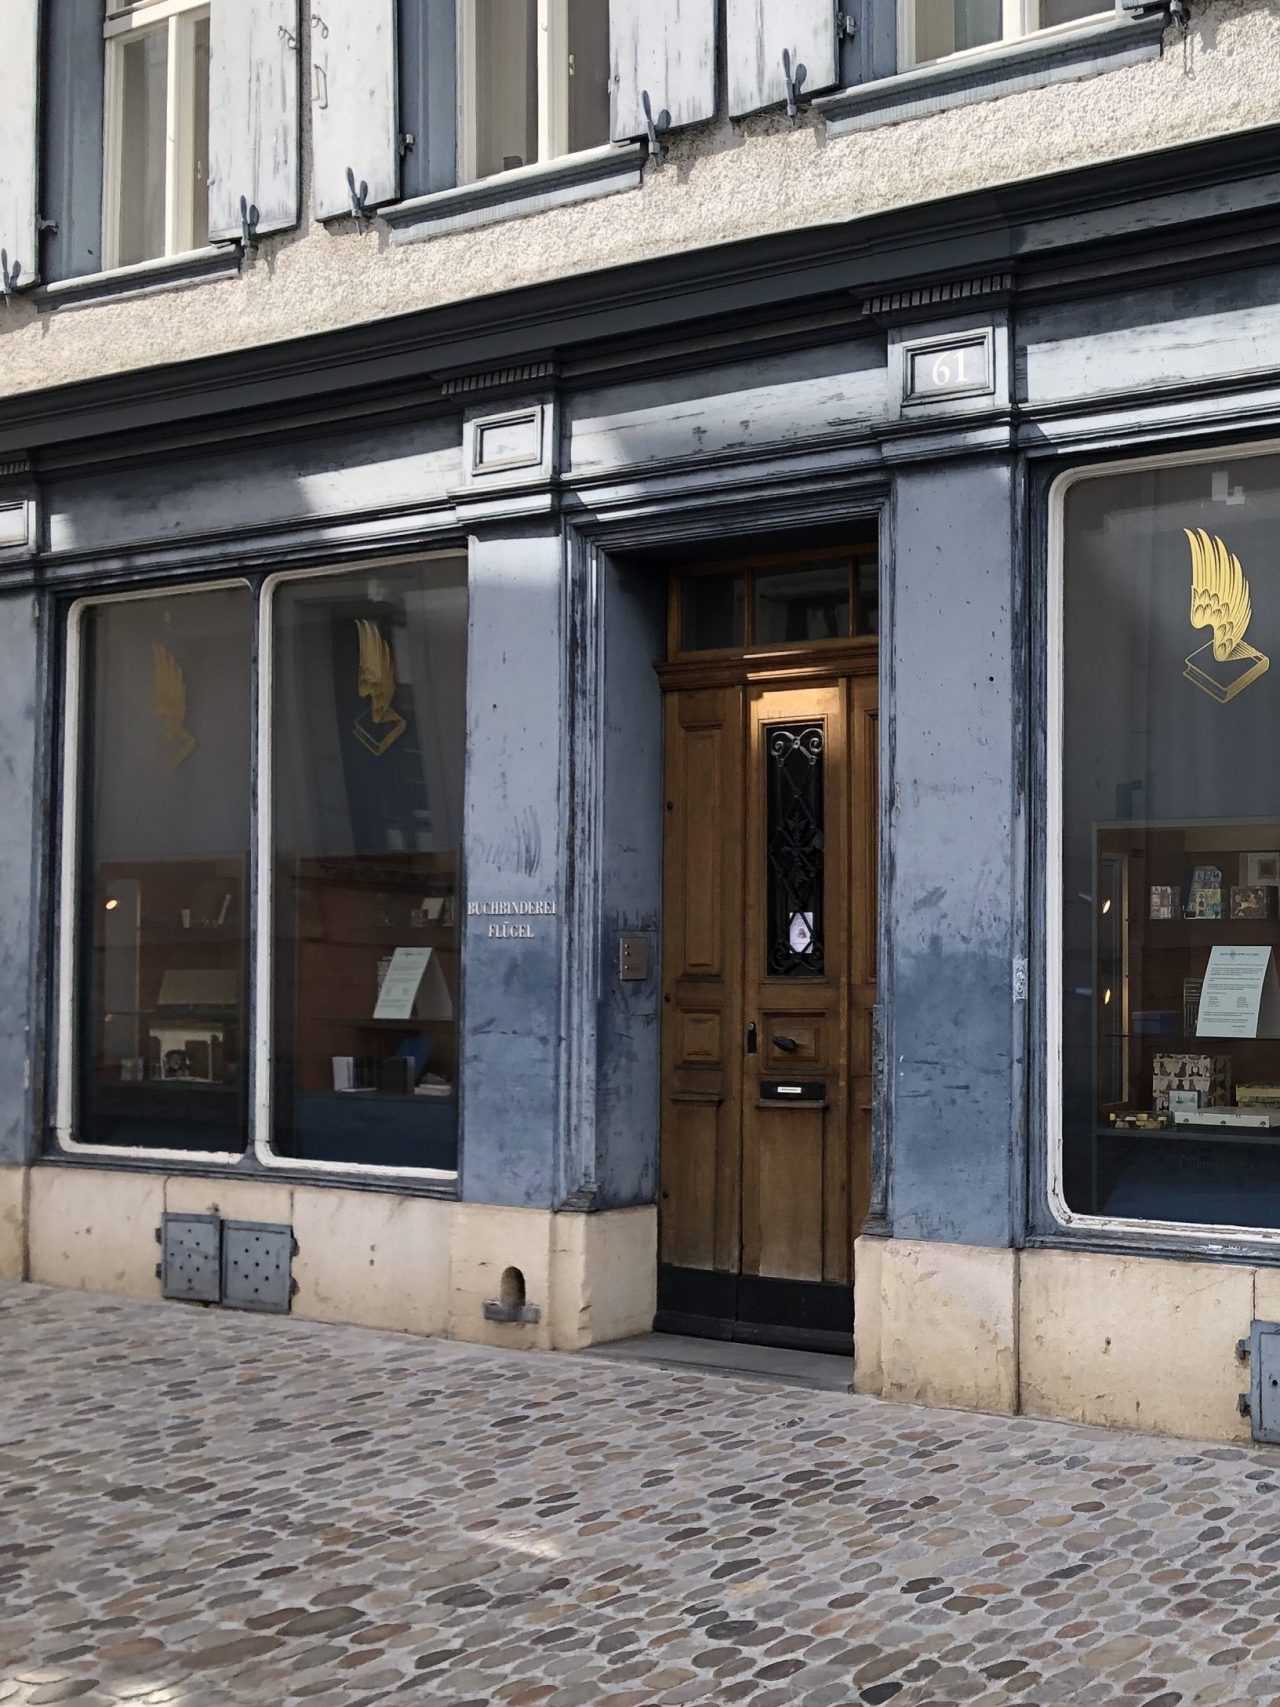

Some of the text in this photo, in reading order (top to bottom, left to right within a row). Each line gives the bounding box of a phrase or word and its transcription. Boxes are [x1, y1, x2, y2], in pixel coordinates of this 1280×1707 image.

[932, 349, 968, 386] 61
[468, 900, 556, 915] BUCHBINDEREI
[488, 921, 535, 938] FLÜGEL
